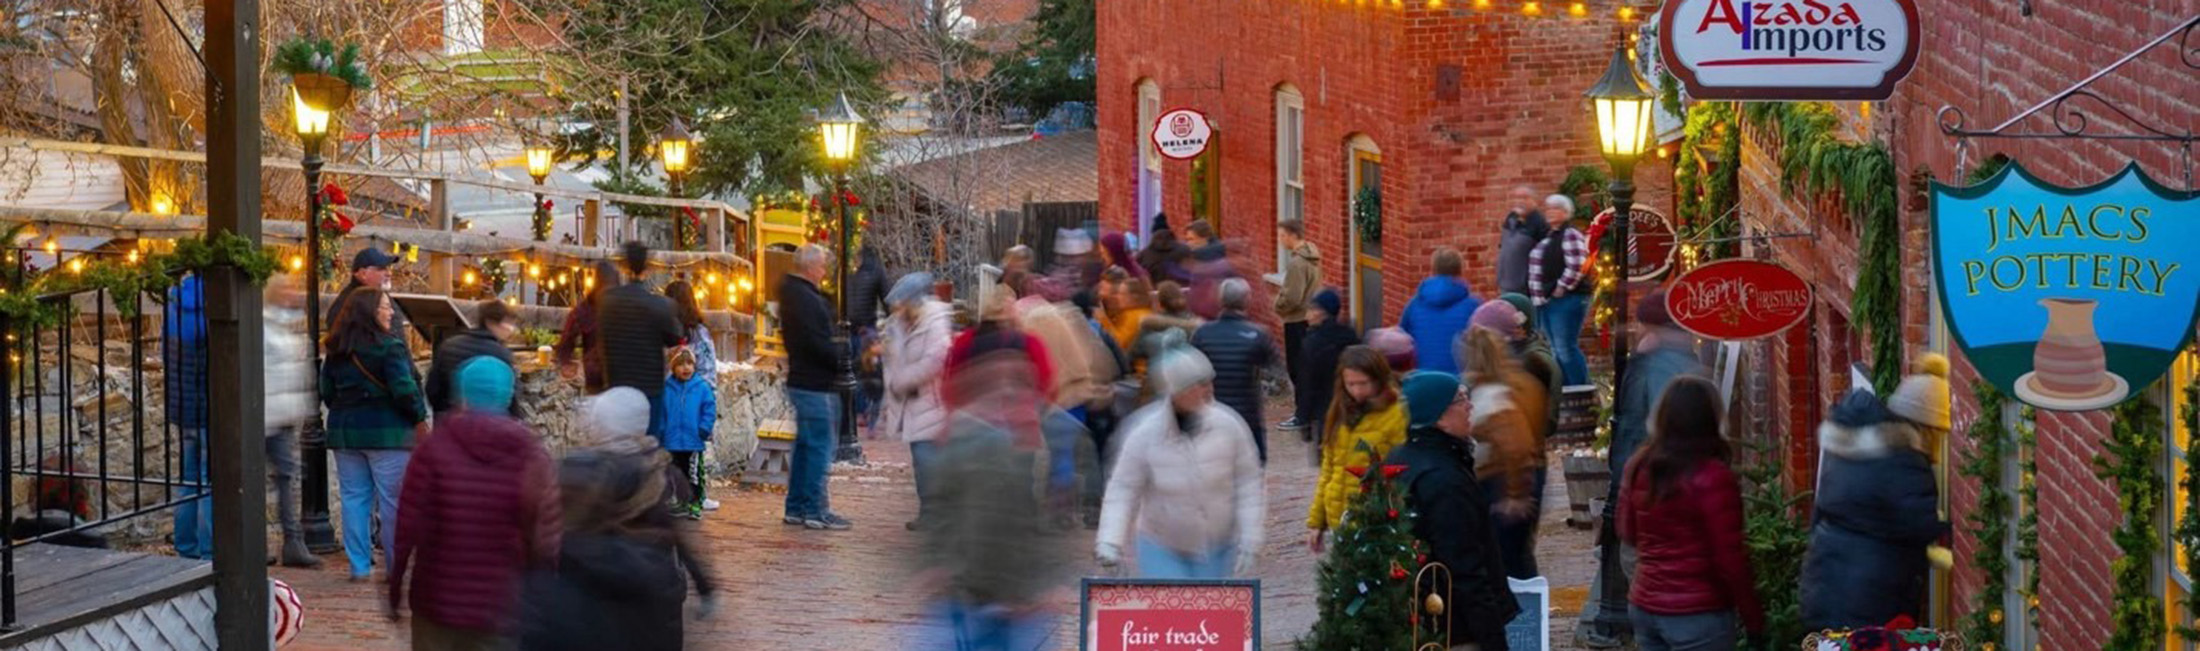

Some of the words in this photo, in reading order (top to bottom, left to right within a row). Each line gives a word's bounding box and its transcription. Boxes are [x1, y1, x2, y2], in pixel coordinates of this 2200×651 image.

[1742, 2, 1886, 57] Imports
[1162, 138, 1203, 147] HELENA
[1628, 211, 1660, 227] DEE'S
[1983, 203, 2152, 253] JMACS
[1961, 252, 2180, 296] POTTERY
[1121, 620, 1158, 651] fair
[1165, 619, 1219, 645] trade
